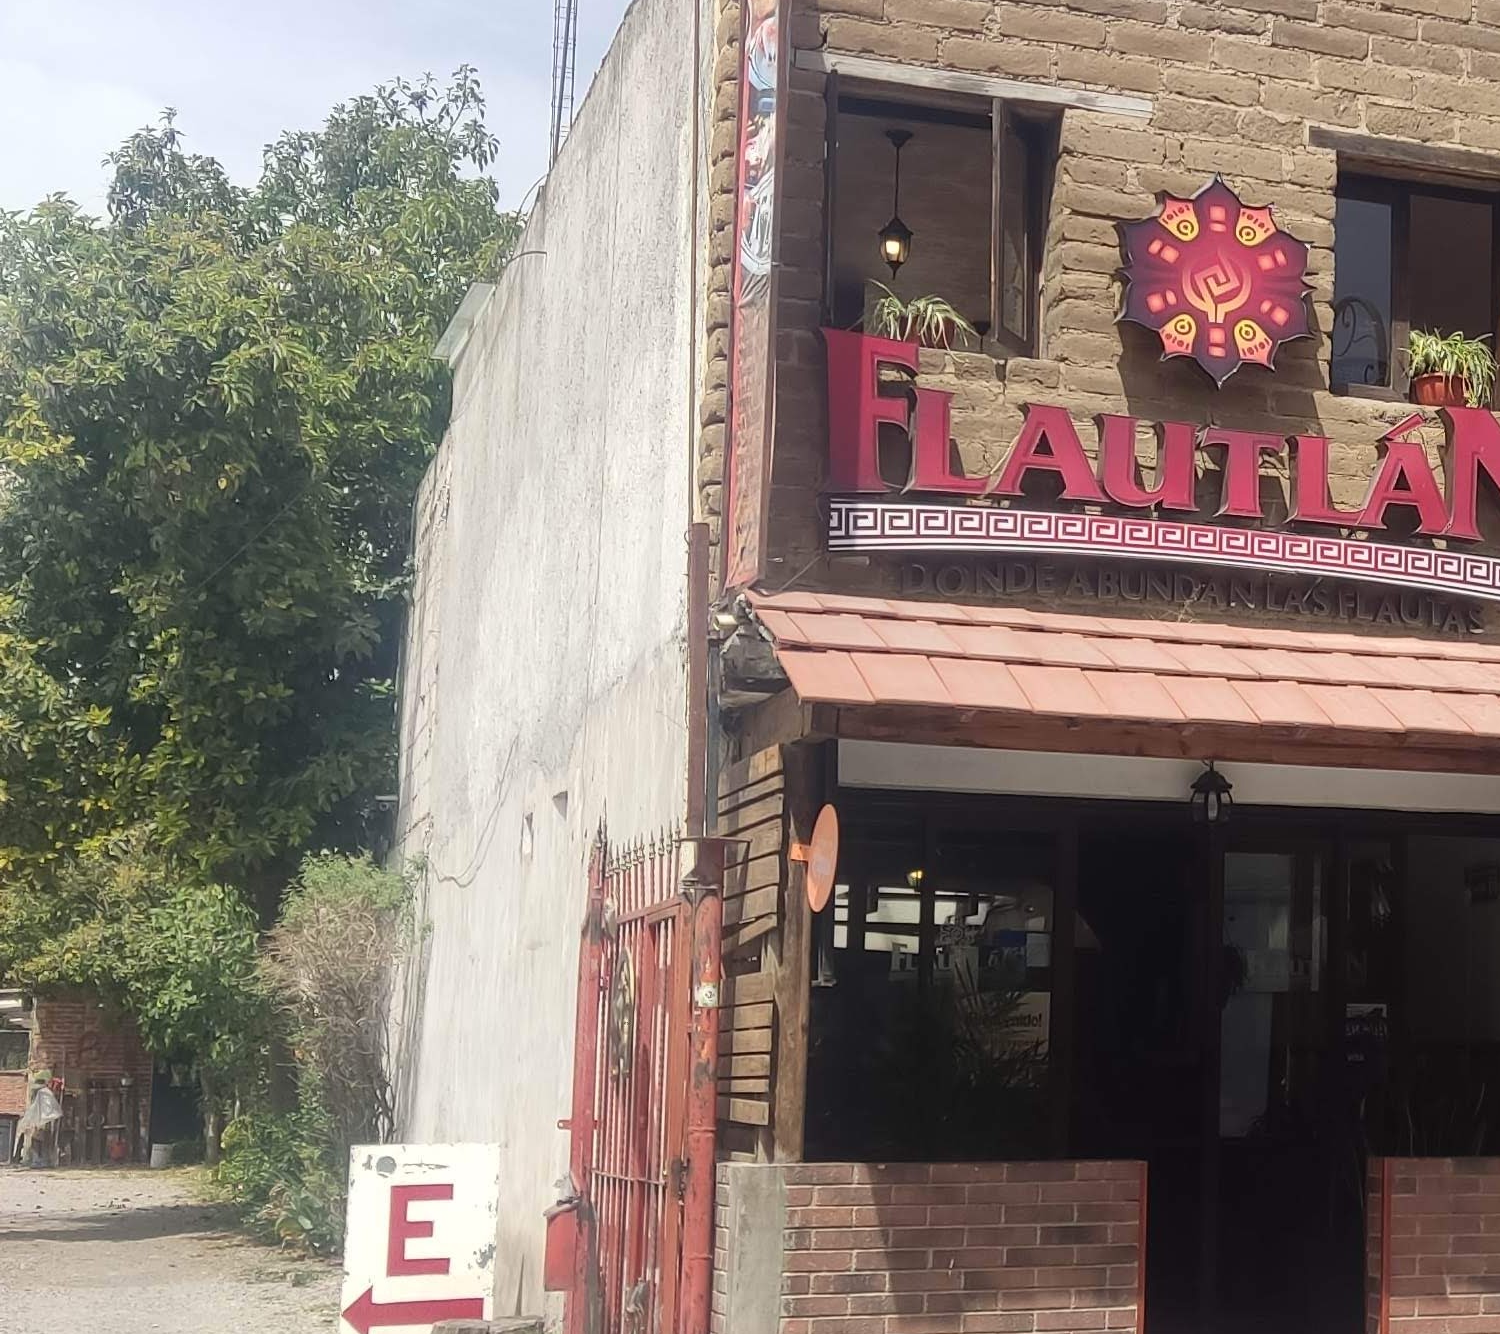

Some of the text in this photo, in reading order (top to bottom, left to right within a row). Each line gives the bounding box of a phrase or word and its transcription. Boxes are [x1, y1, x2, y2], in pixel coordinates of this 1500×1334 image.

[903, 563, 1485, 635] DONDE ABUNDAN LAS FLAUTAS
[386, 1183, 455, 1278] E
